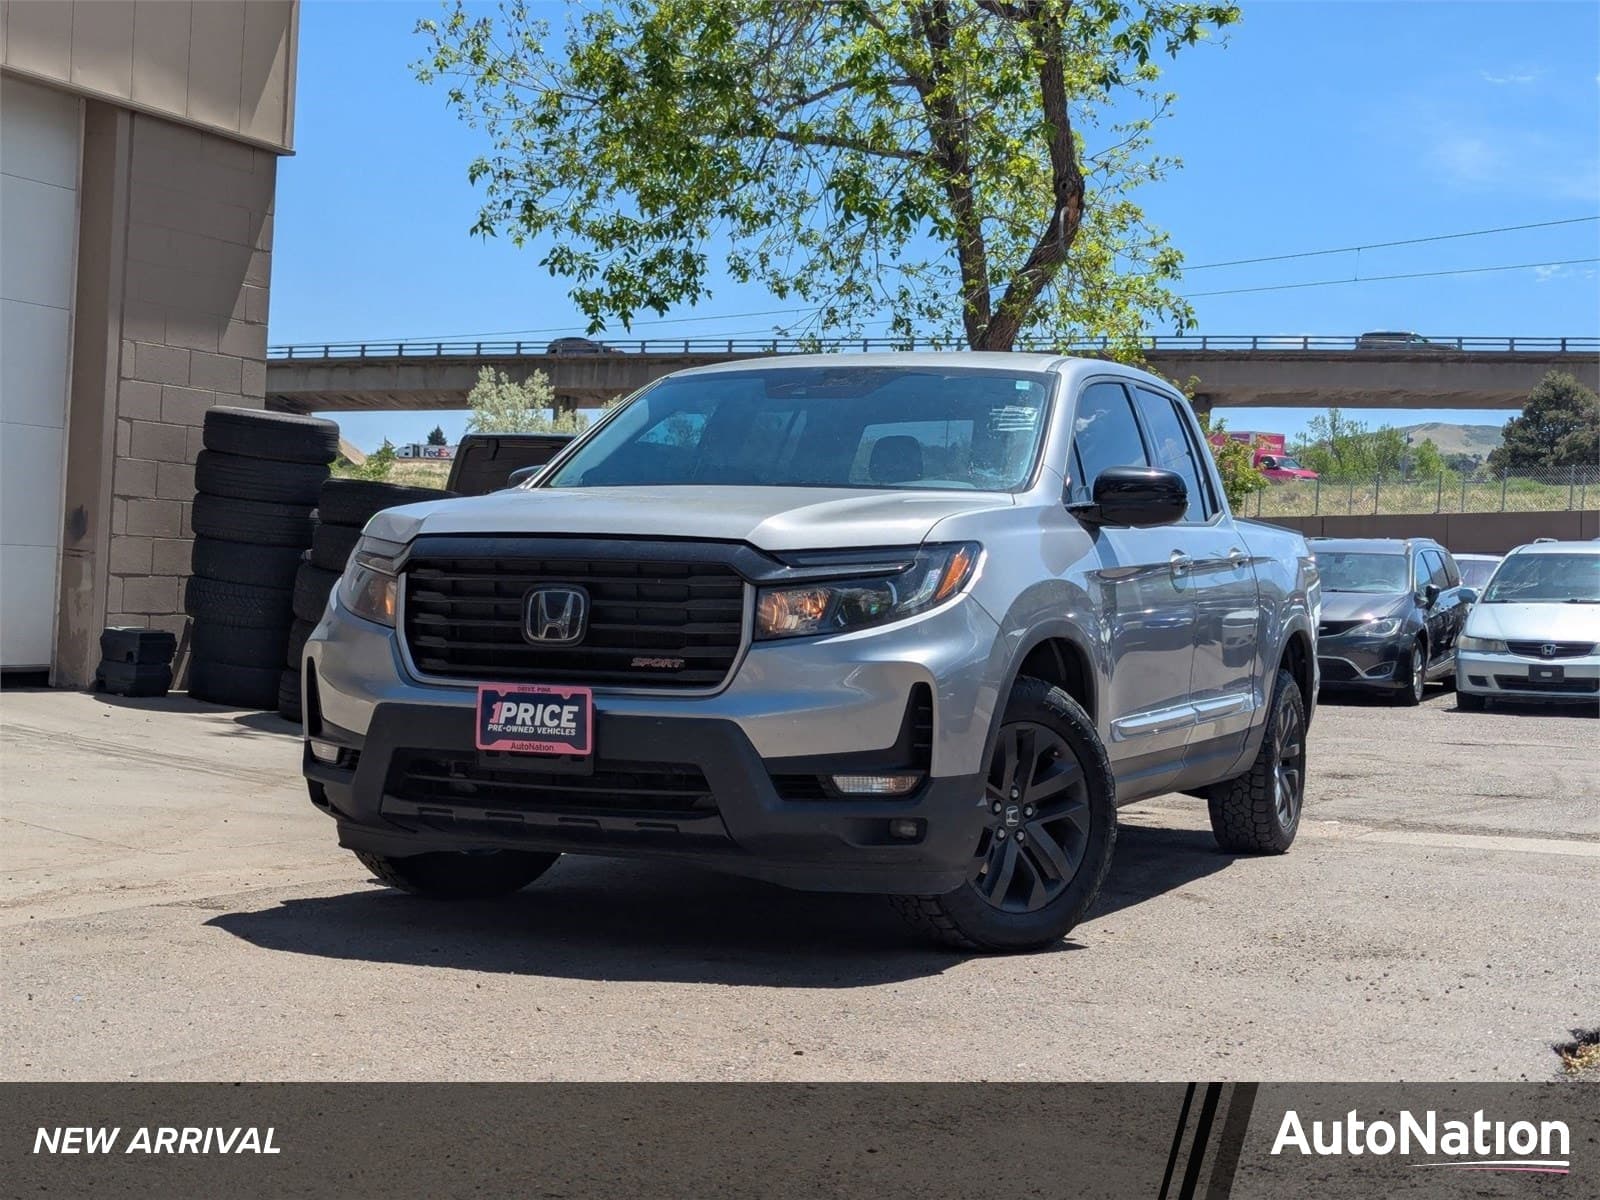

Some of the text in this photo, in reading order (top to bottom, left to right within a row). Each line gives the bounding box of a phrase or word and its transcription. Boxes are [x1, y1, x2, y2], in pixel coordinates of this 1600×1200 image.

[631, 658, 684, 668] SPORT
[488, 724, 576, 736] PRE-OWNED VEHICLES
[511, 742, 554, 751] AutoNation
